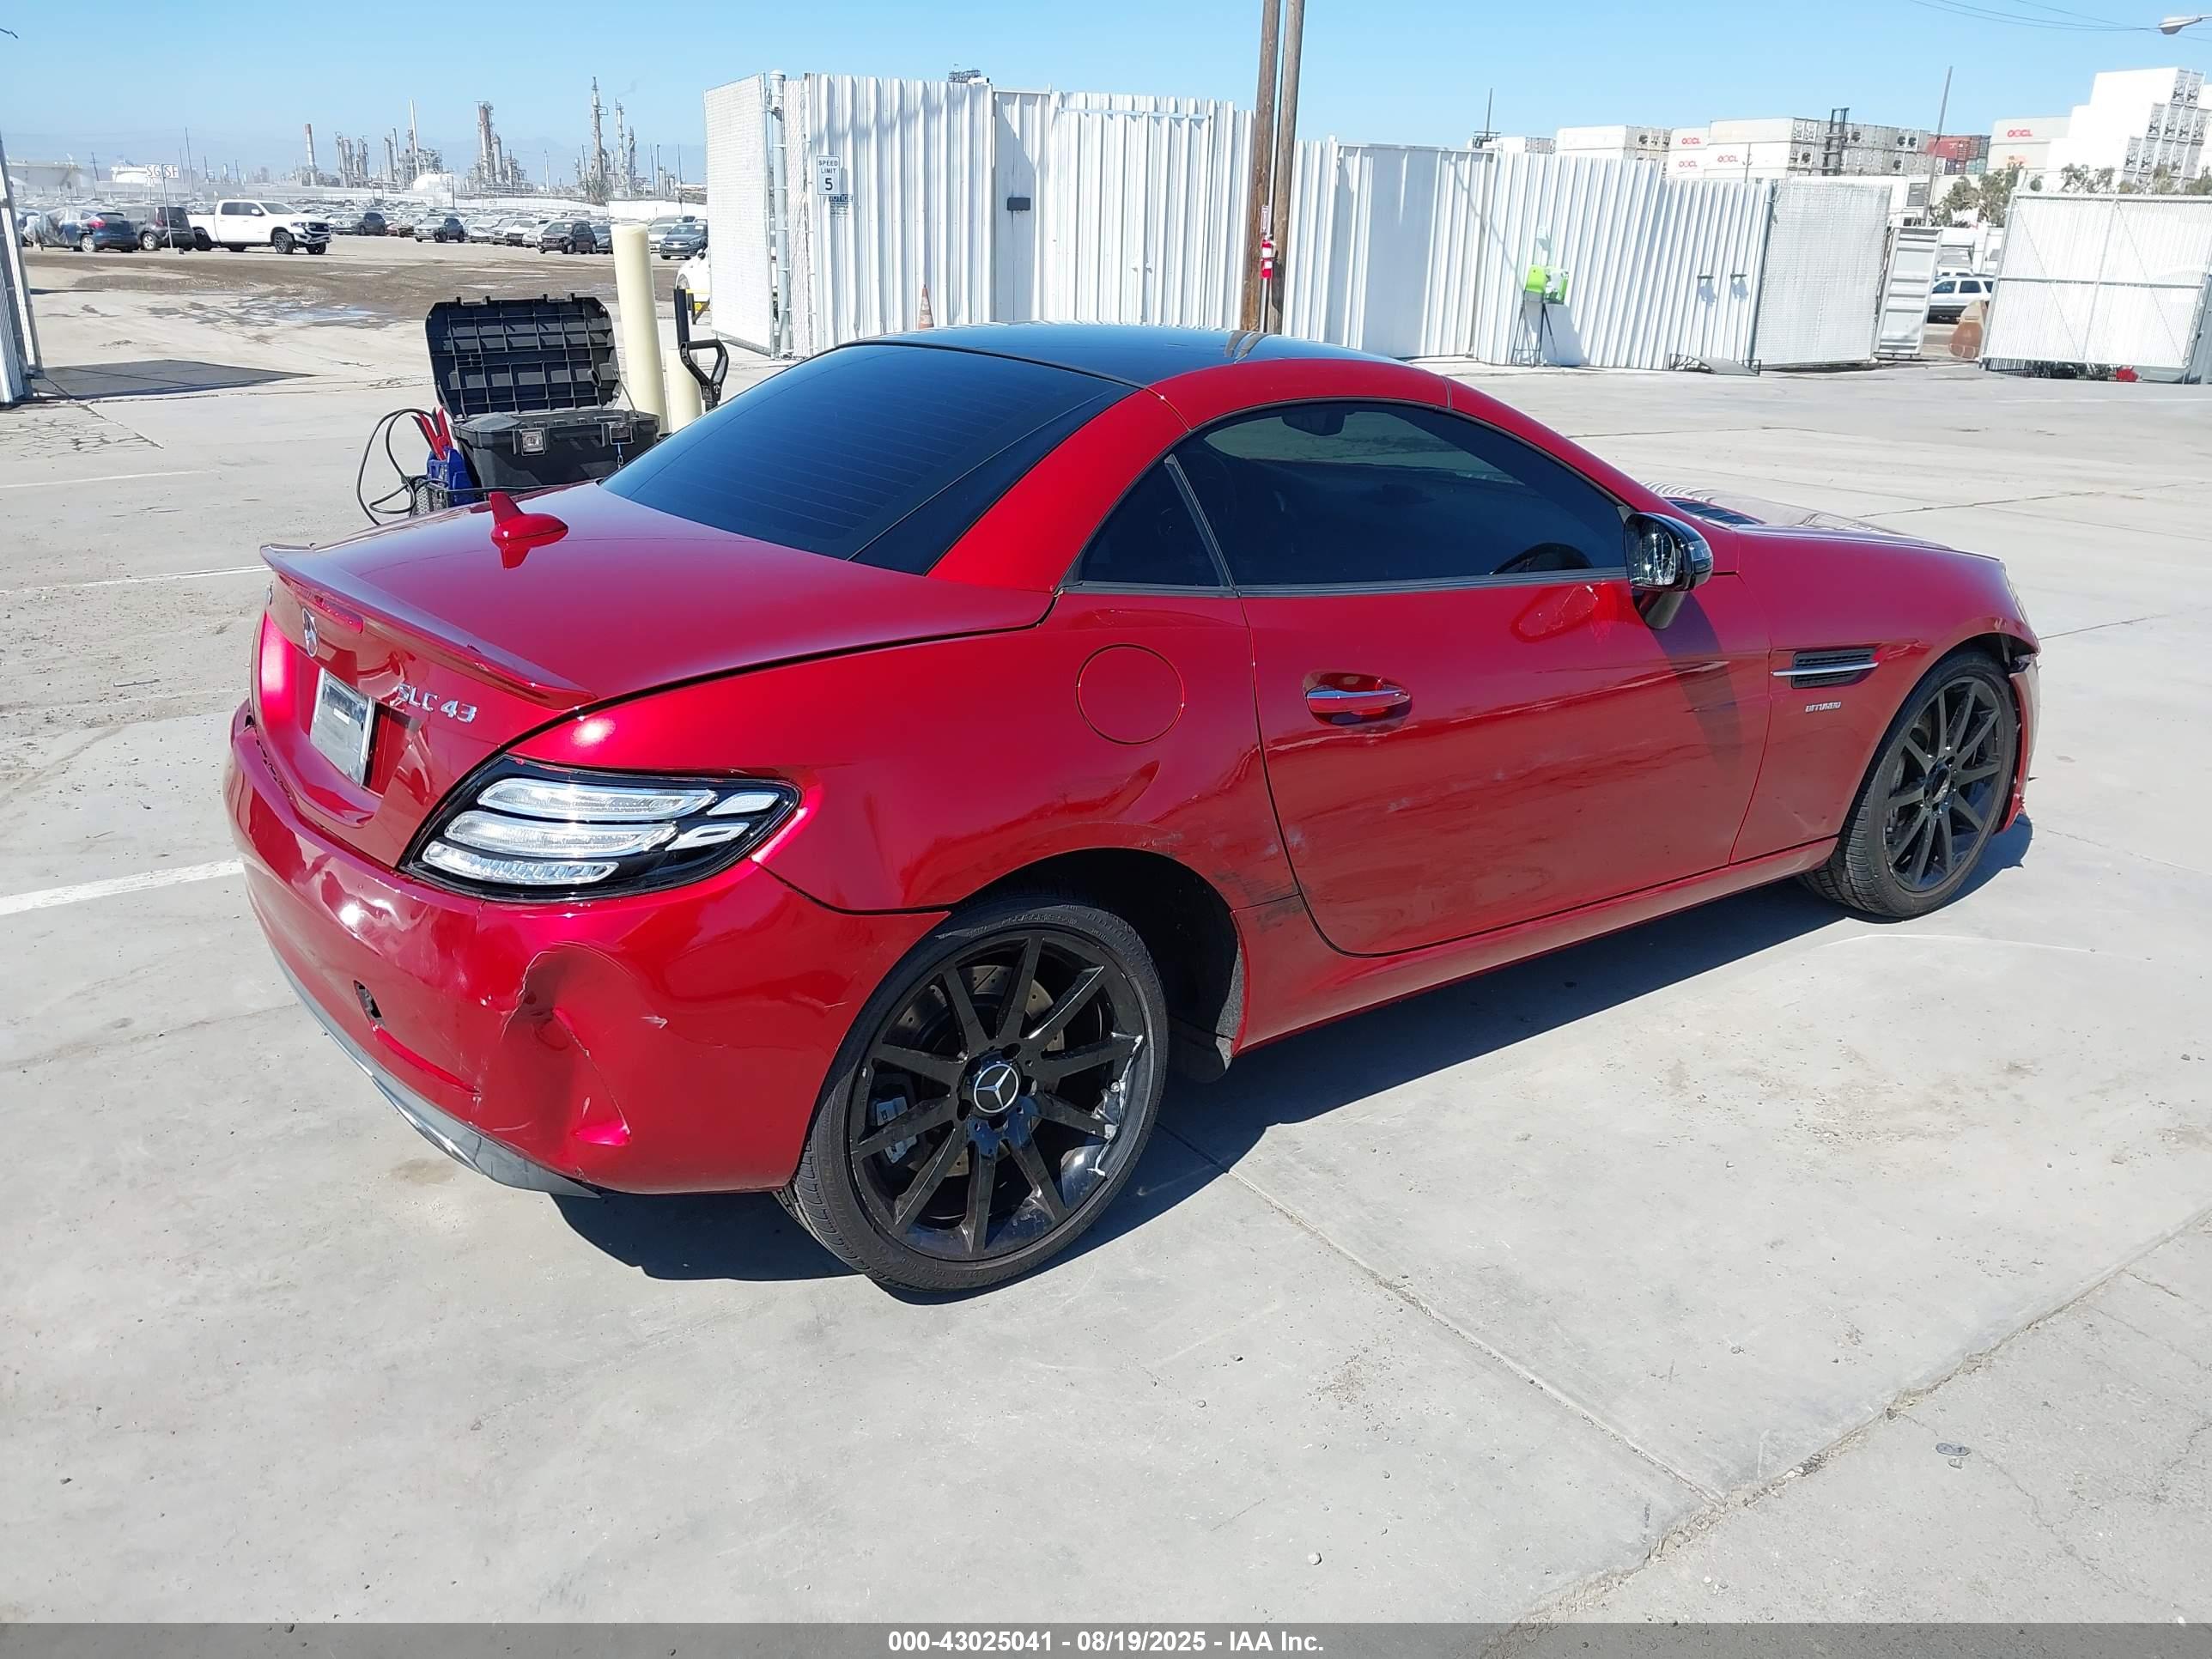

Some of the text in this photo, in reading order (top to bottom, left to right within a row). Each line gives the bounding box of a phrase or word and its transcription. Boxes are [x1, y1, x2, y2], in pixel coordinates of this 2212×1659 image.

[146, 165, 161, 177] SG
[164, 165, 178, 178] SF
[825, 177, 833, 190] 5
[440, 700, 477, 724] 43
